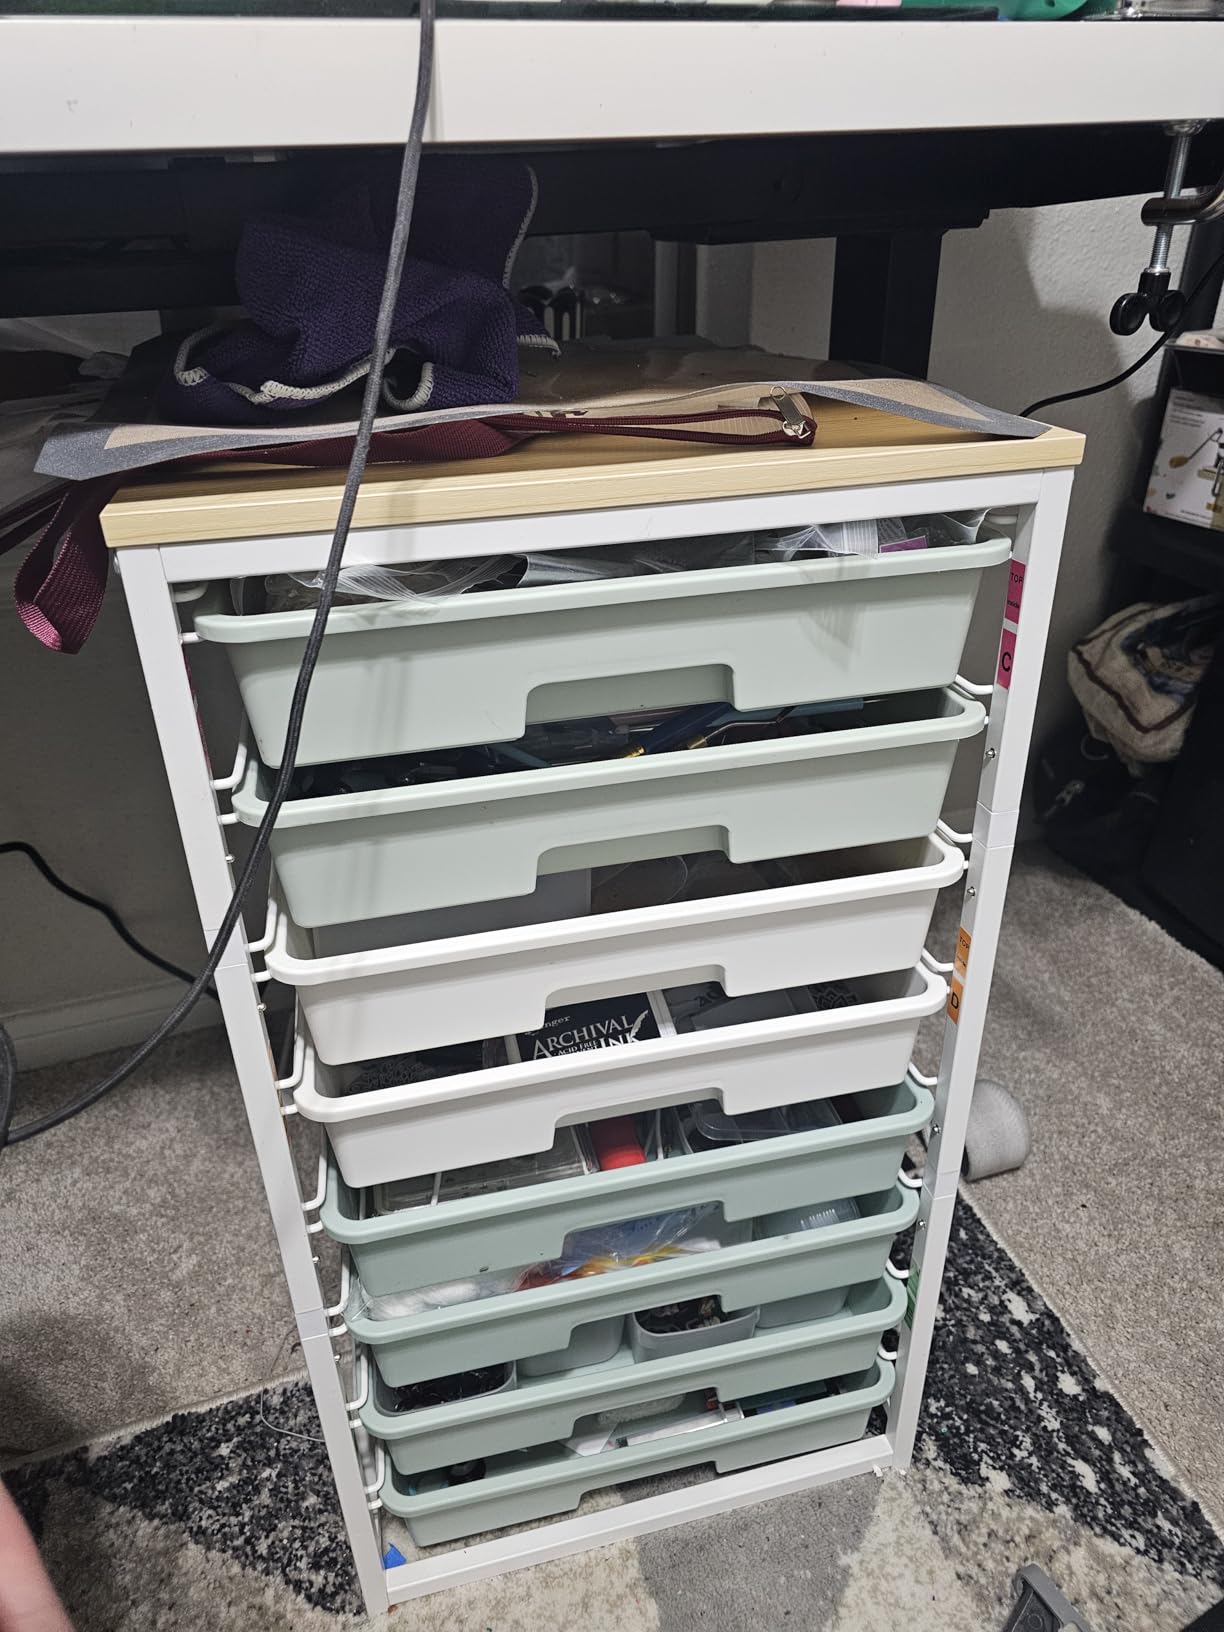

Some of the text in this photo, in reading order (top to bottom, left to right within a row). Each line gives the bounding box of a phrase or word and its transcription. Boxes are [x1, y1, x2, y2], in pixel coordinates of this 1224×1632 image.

[1002, 652, 1012, 672] C
[951, 992, 959, 1009] D
[533, 1015, 634, 1059] ARCHIVAL
